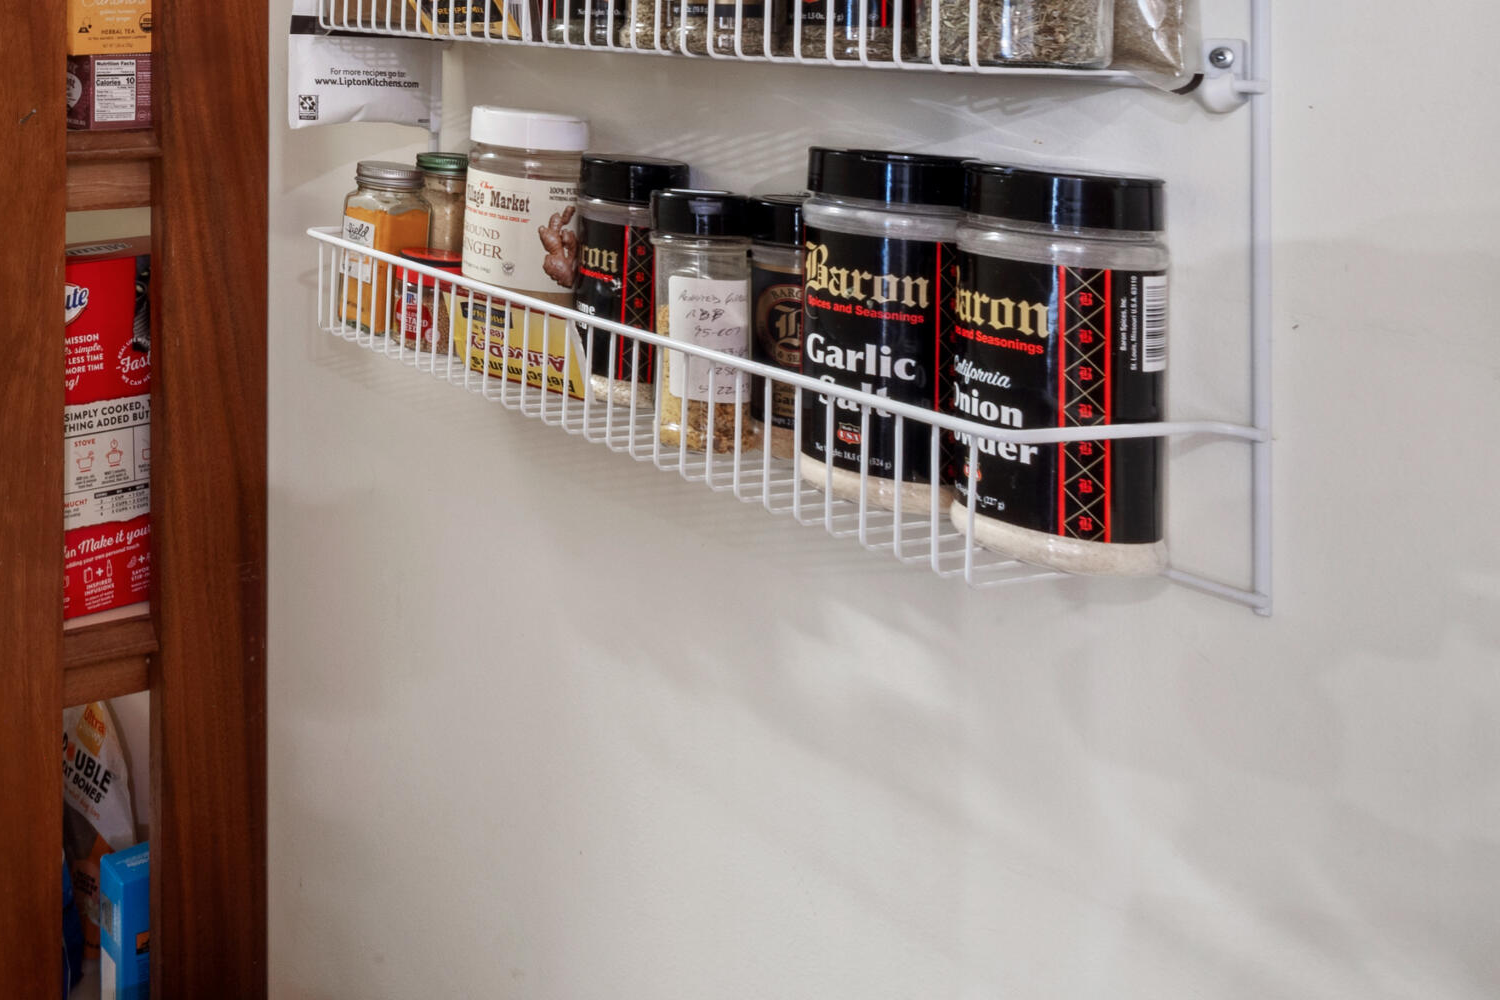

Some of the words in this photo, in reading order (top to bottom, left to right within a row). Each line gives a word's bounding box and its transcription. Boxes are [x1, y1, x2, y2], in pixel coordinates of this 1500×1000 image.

[96, 79, 121, 87] Calories
[126, 76, 135, 85] 10
[315, 77, 419, 88] www.LiptonKitchens.com
[362, 69, 387, 78] recipes
[490, 190, 530, 213] Market
[550, 187, 564, 195] 100%
[466, 222, 500, 240] ROUND
[464, 236, 503, 260] NGER
[580, 244, 618, 273] ron
[806, 241, 930, 309] Baron
[65, 287, 89, 309] ute
[770, 287, 803, 300] BARO
[808, 294, 832, 310] Spices
[833, 301, 853, 314] and
[855, 305, 925, 324] Seasonings
[955, 282, 1050, 338] aron
[975, 331, 1044, 355] Seasonings
[68, 356, 85, 365] LESS
[87, 353, 104, 362] TIME
[87, 363, 104, 371] TIME
[806, 332, 917, 381] Garlic
[64, 409, 98, 422] SIMPLY
[101, 401, 145, 415] COOKED,
[64, 421, 94, 433] THING
[97, 414, 130, 427] ADDED
[132, 410, 150, 421] BUT
[74, 438, 96, 447] STOVE
[78, 534, 114, 554] Make
[115, 530, 126, 544] it
